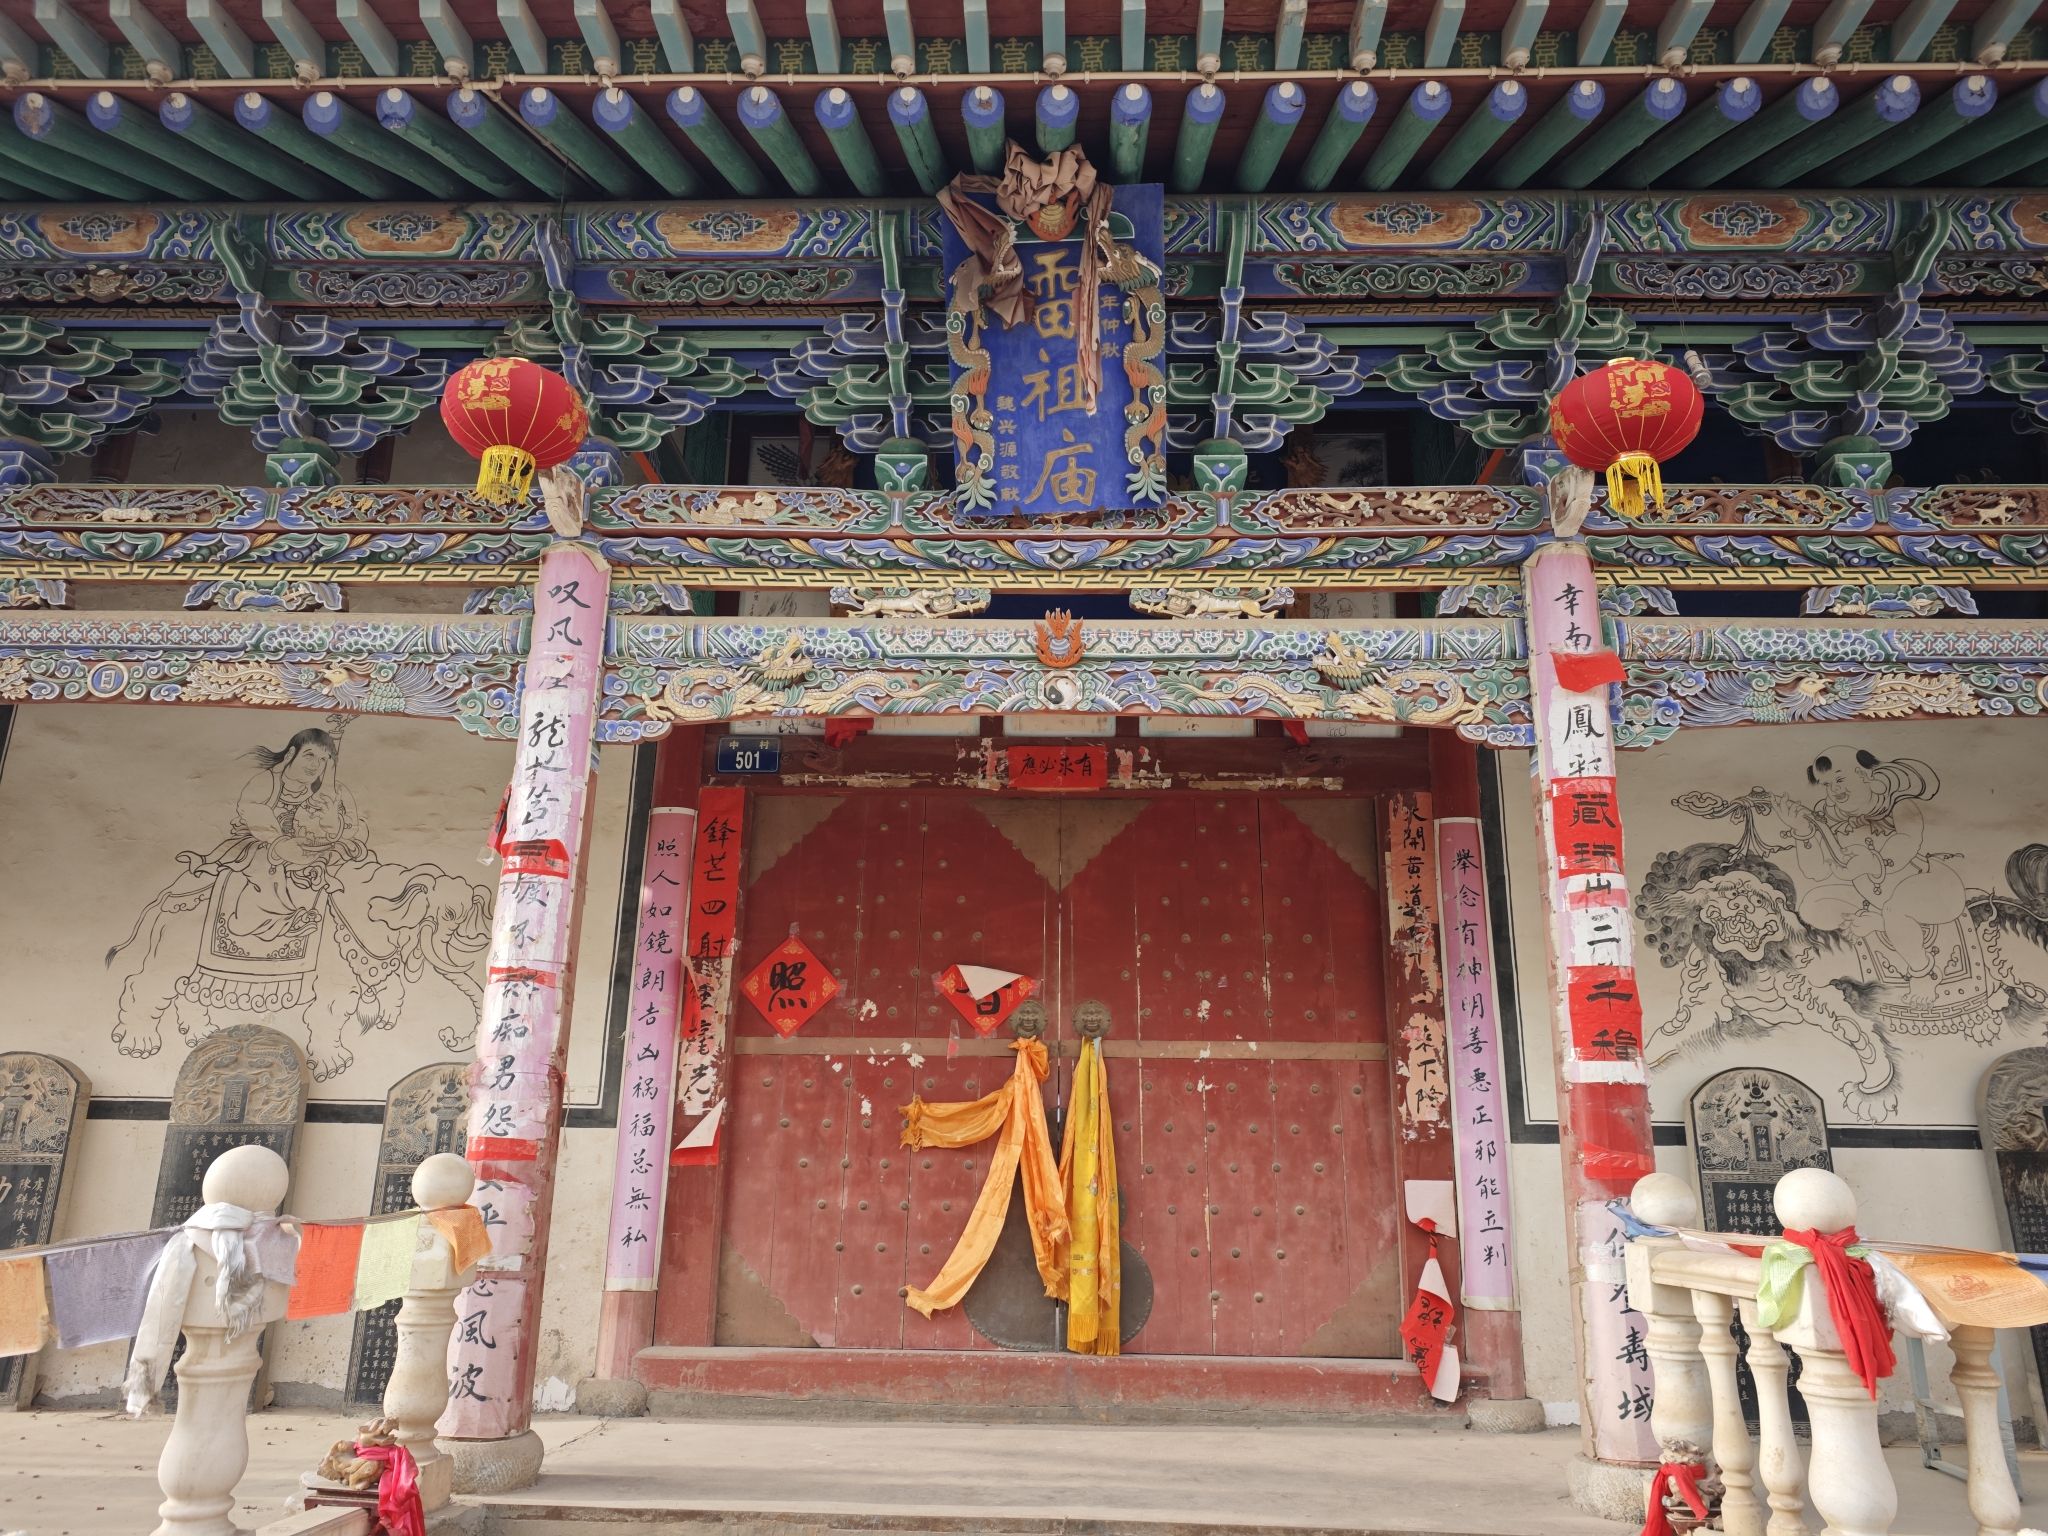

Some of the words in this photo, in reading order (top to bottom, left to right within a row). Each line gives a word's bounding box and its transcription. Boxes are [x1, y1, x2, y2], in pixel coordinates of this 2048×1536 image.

[735, 751, 760, 769] 501
[1020, 752, 1093, 777] 有求必應
